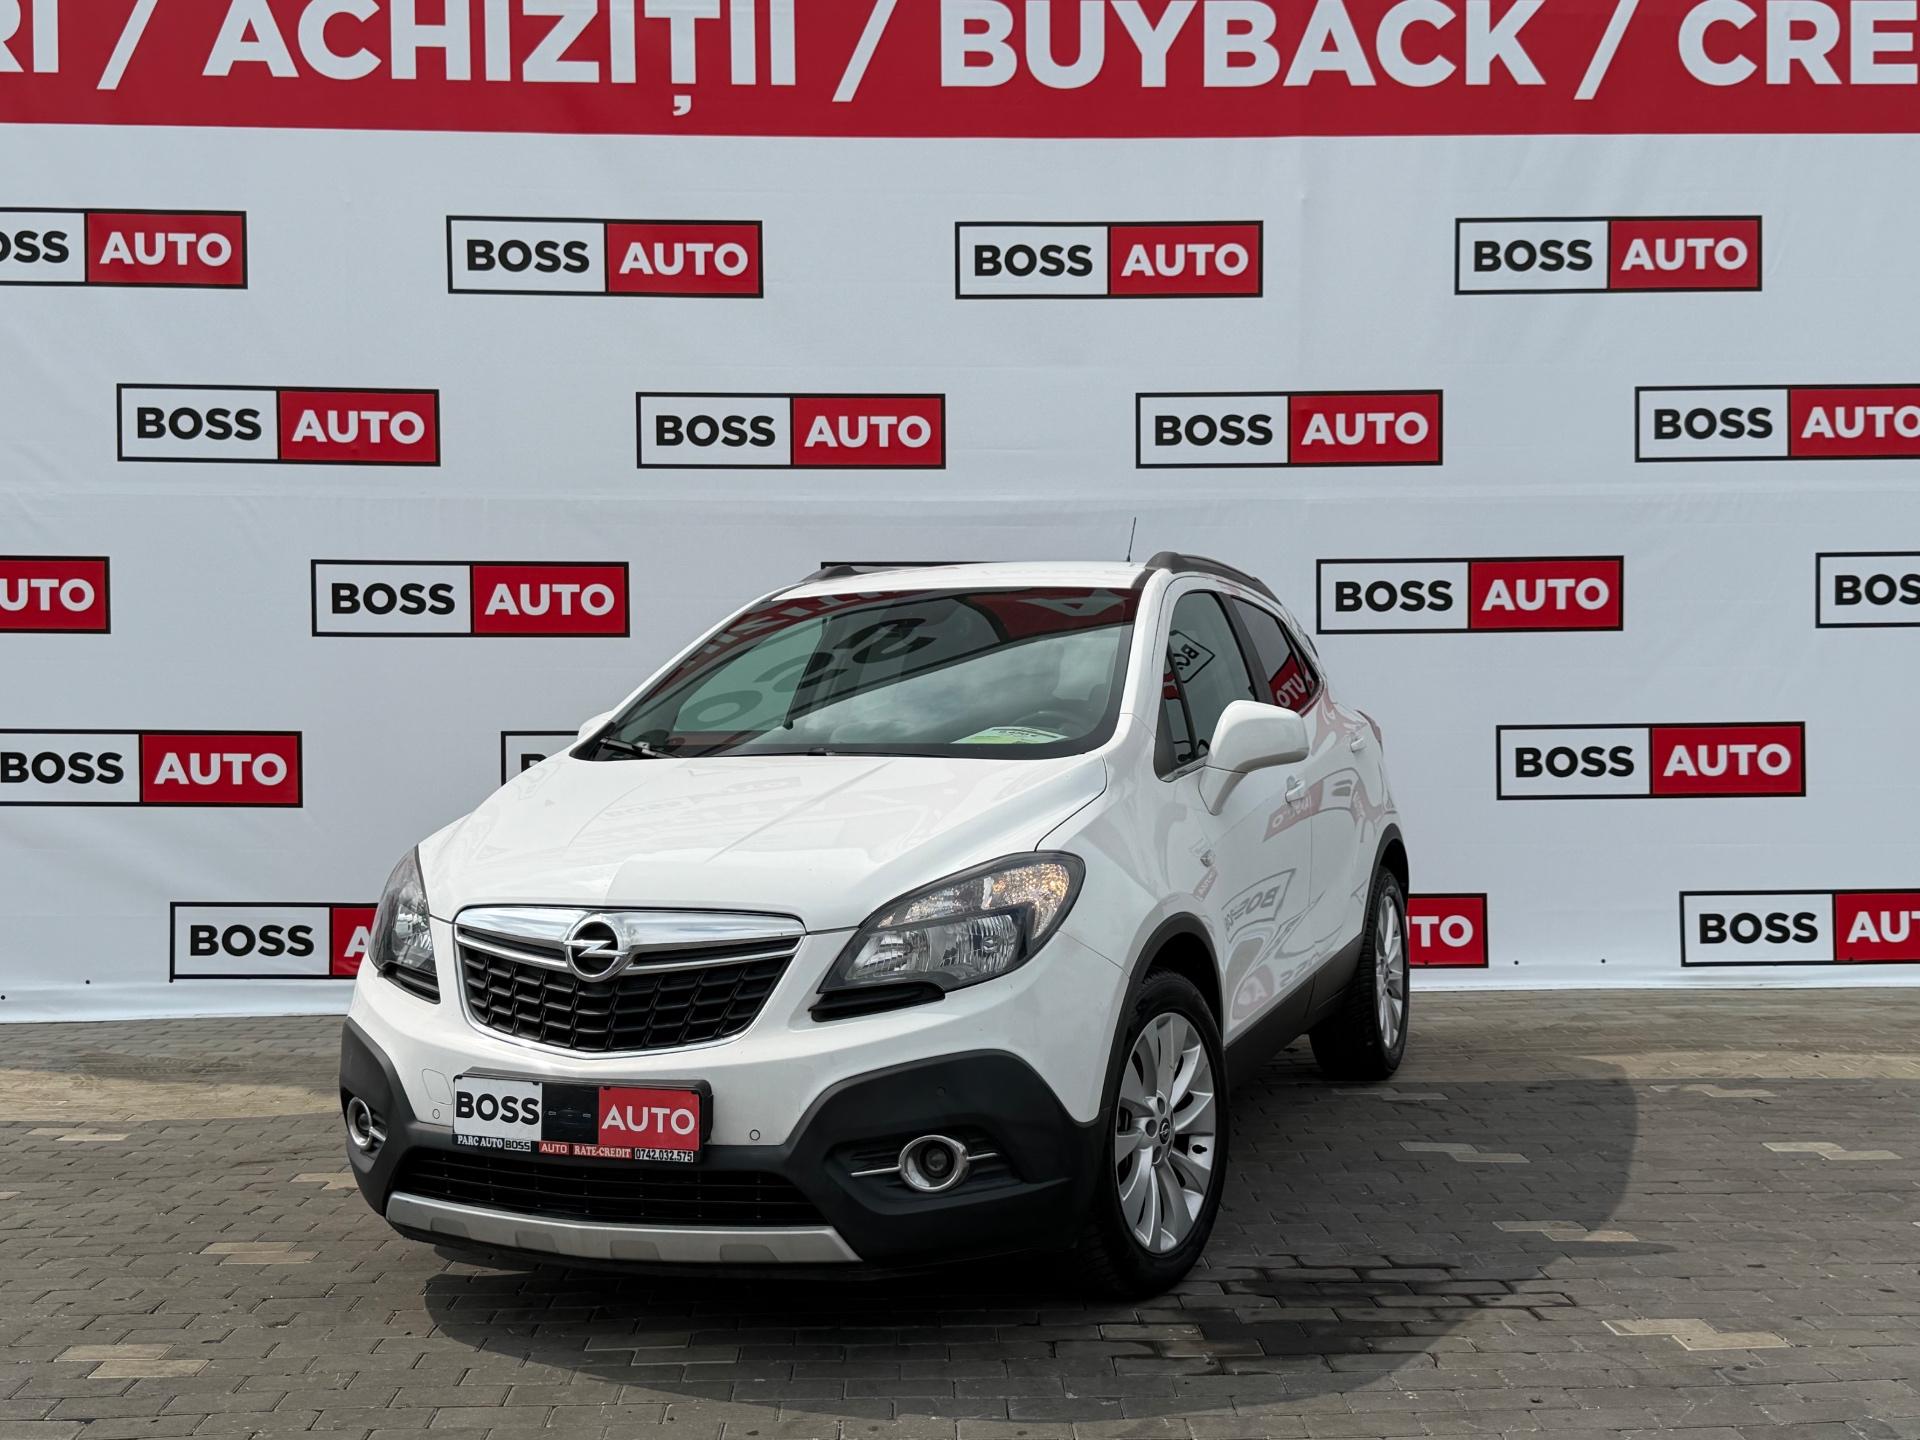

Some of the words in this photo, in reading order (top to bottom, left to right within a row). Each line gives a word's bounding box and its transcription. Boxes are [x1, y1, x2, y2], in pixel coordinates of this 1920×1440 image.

[97, 0, 158, 90] /
[203, 0, 796, 115] ACHIZIȚII
[833, 0, 897, 103] /
[940, 0, 1545, 88] BUYBACK
[1574, 0, 1639, 101] /
[1678, 0, 1918, 86] CRE
[100, 231, 233, 267] AUTO
[466, 239, 590, 274] BOSS
[619, 241, 749, 277] AUTO
[974, 244, 1093, 277] BOSS
[1121, 242, 1249, 277] AUTO
[1474, 239, 1593, 272] BOSS
[1620, 236, 1749, 271] AUTO
[137, 407, 262, 441] BOSS
[291, 409, 425, 445] AUTO
[655, 414, 776, 447] BOSS
[804, 415, 932, 449] AUTO
[1155, 414, 1273, 446] BOSS
[1301, 411, 1429, 446] AUTO
[1654, 407, 1773, 440] BOSS
[1801, 405, 1920, 438] AUTO
[331, 582, 456, 615] BOSS
[484, 583, 615, 617] AUTO
[1335, 580, 1453, 612] BOSS
[1481, 577, 1610, 612] AUTO
[0, 751, 124, 785] BOSS
[153, 752, 288, 786] AUTO
[1515, 745, 1635, 778] BOSS
[1663, 743, 1792, 777] AUTO
[190, 924, 315, 957] BOSS
[1405, 914, 1474, 948] TO
[1699, 911, 1818, 945] BOSS
[455, 1090, 540, 1126] BOSS
[601, 1103, 696, 1136] AUTO
[457, 1134, 479, 1146] PARC
[480, 1137, 503, 1149] AUTO
[505, 1140, 531, 1151] BOSS
[541, 1143, 567, 1154] AUTO
